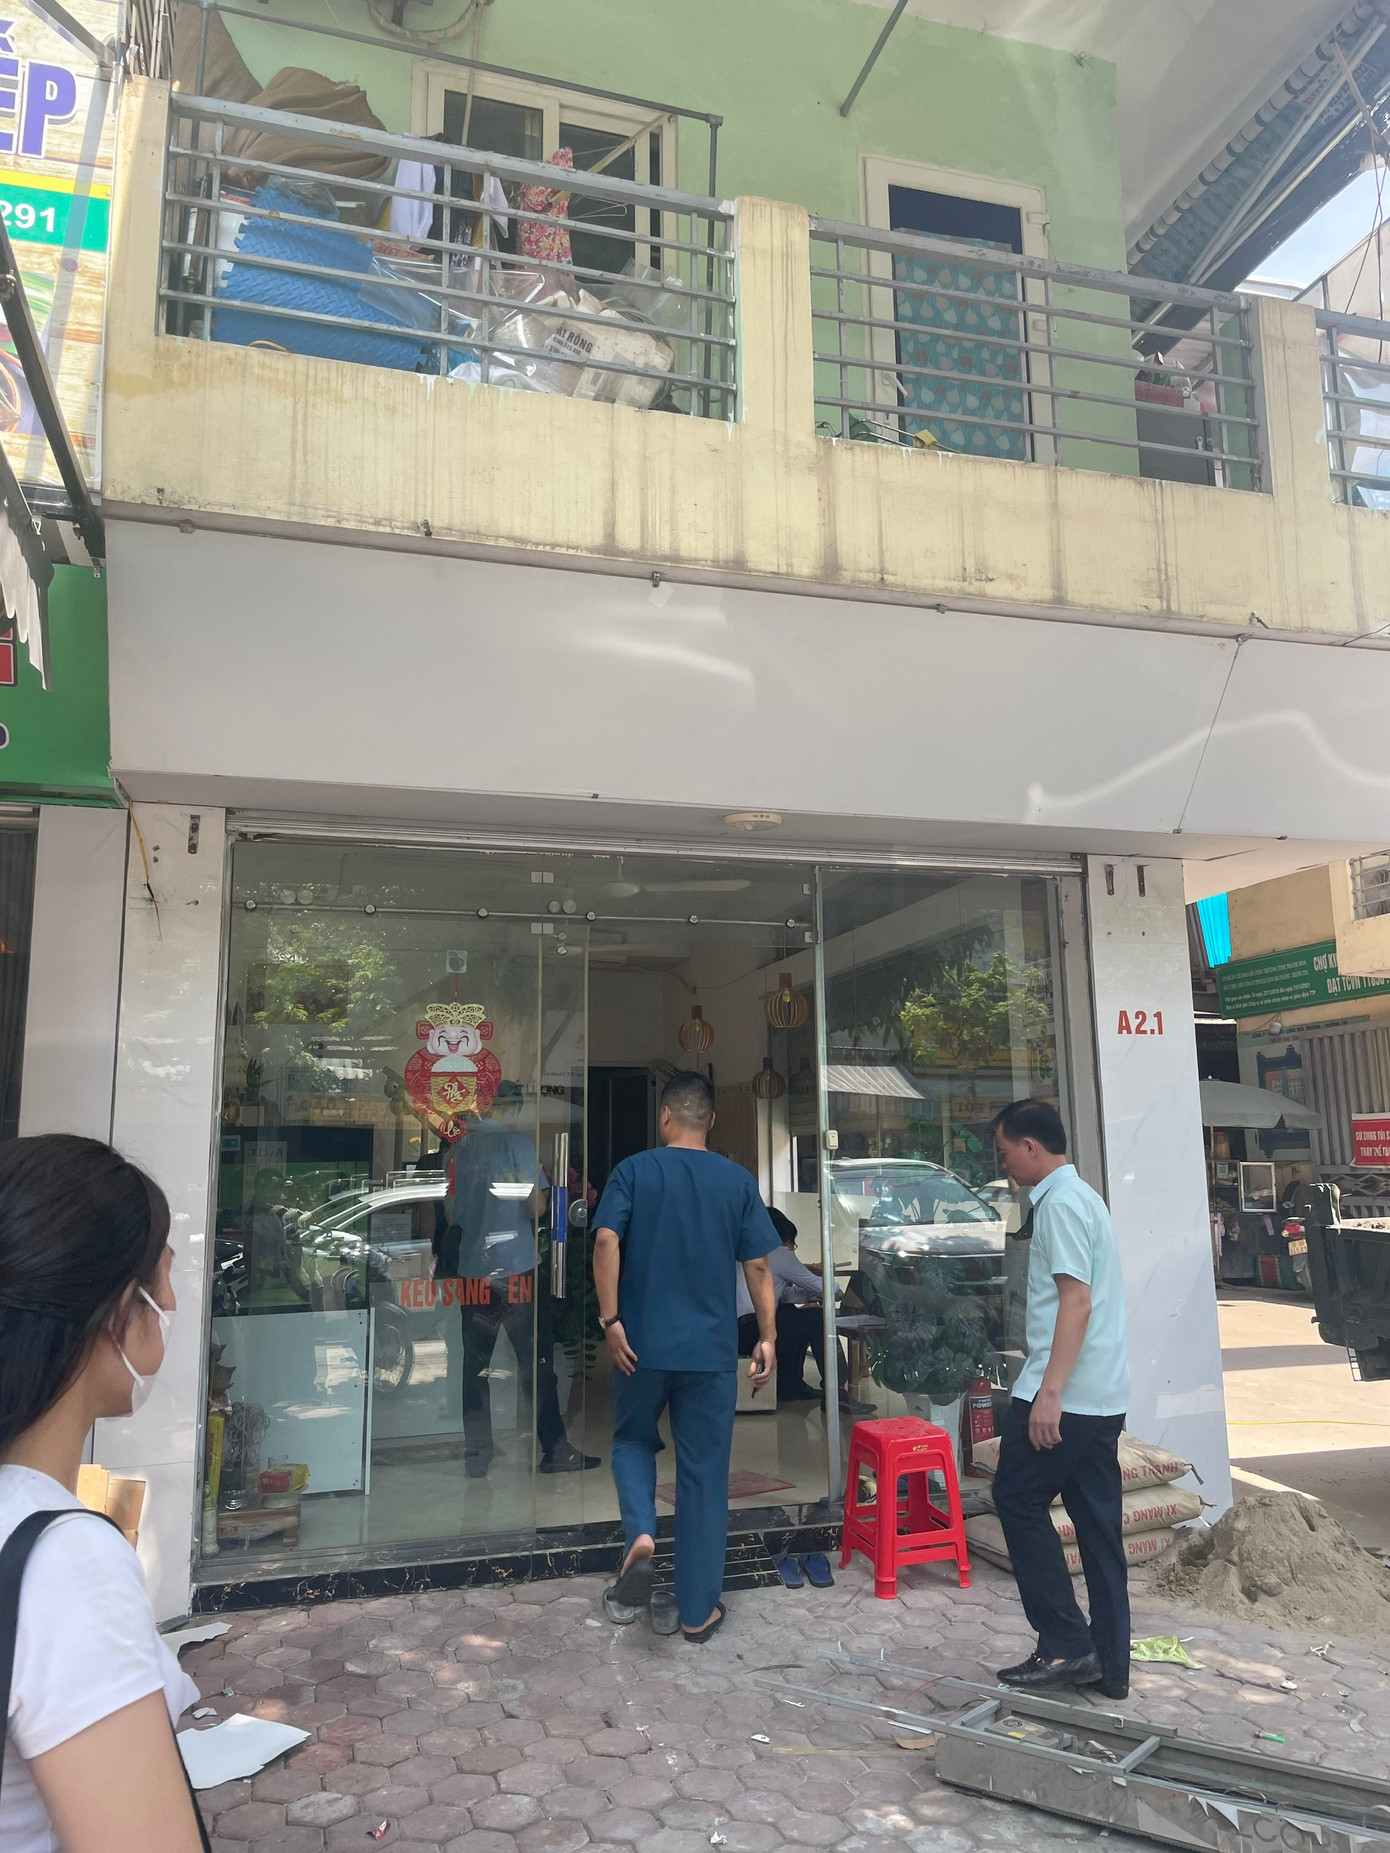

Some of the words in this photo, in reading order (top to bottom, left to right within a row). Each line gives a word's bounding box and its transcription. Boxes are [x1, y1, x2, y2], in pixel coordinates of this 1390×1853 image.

[1117, 1010, 1163, 1035] A2.1
[442, 1276, 492, 1307] SANG
[1122, 1467, 1139, 1480] NG
